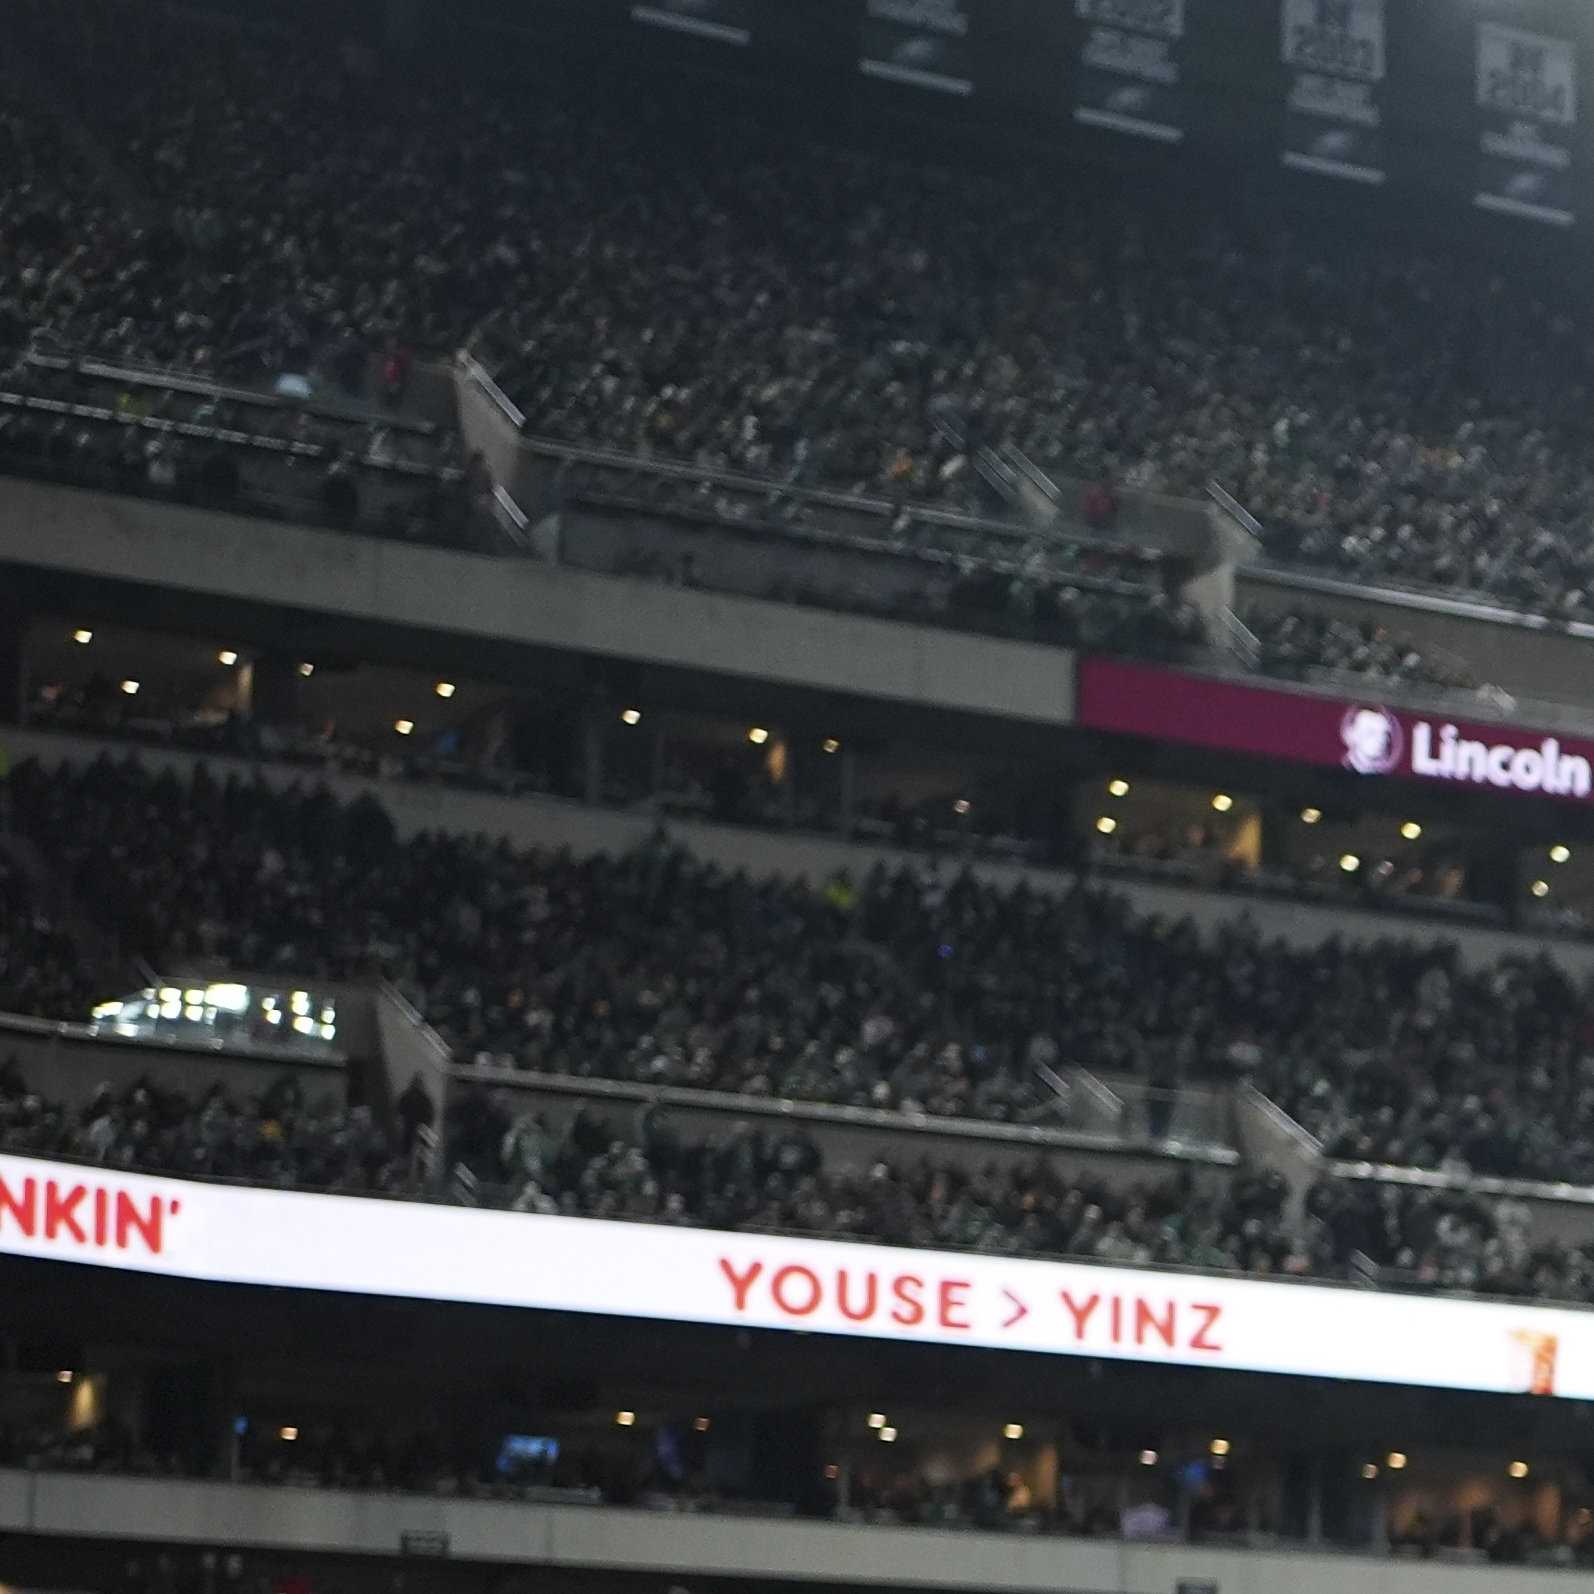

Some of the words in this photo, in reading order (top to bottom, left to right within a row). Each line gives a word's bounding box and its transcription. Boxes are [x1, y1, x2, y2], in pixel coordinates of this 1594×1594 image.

[1411, 722, 1591, 797] Lincoln
[720, 1258, 971, 1329] YOUSE
[1061, 1290, 1224, 1352] YINZ
